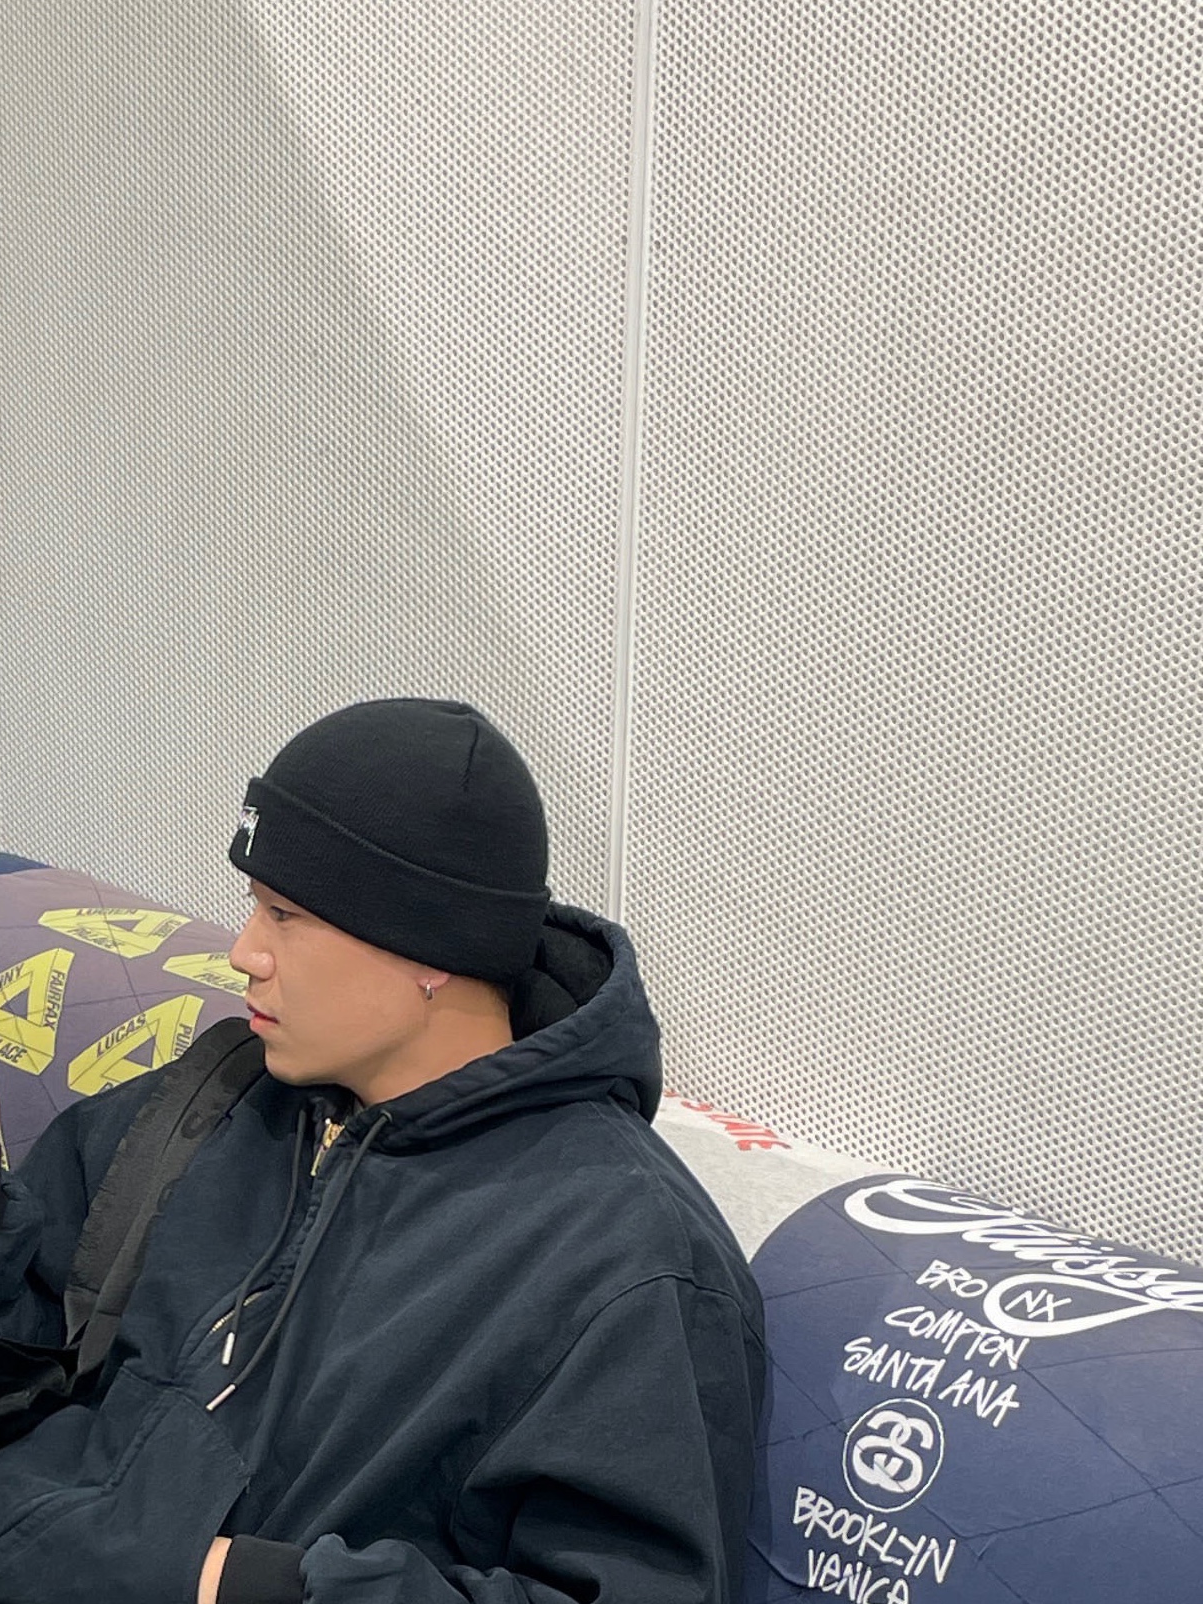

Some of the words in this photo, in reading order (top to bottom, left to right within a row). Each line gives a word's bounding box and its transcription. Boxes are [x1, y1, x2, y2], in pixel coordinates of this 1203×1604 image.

[43, 969, 66, 1032] FAIRFAX
[96, 1013, 148, 1056] LUCAS
[884, 1305, 1031, 1371] COMPTON
[843, 1336, 947, 1399] SANTA
[938, 1369, 1020, 1428] ANA
[792, 1486, 957, 1584] BROOKLYN
